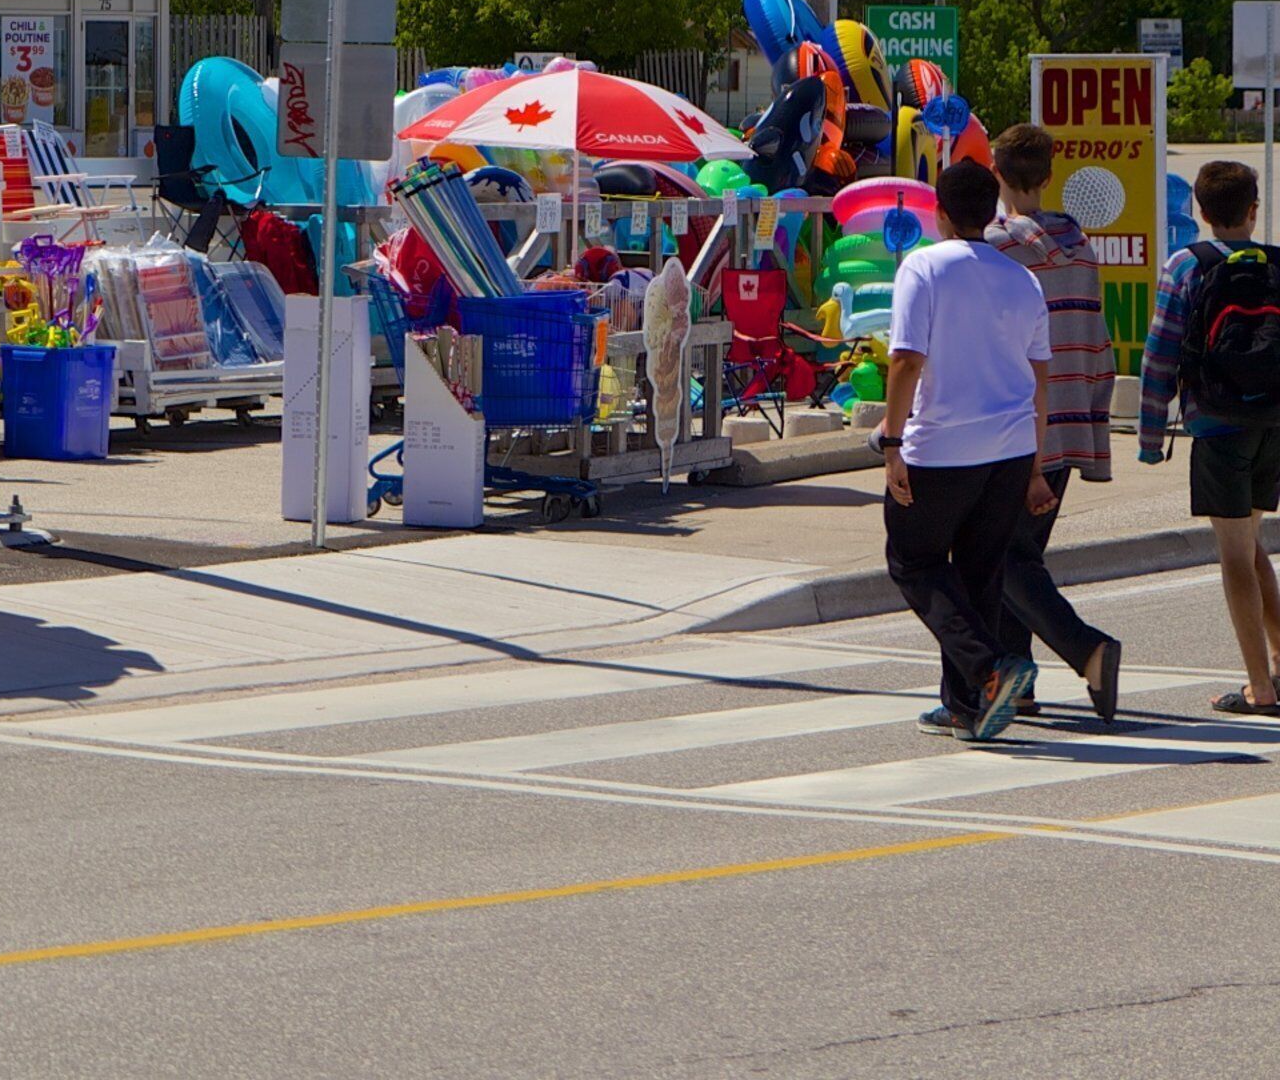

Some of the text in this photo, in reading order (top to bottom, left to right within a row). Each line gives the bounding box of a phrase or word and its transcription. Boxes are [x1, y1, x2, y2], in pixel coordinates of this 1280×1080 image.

[10, 21, 36, 31] CHILI
[888, 11, 936, 30] CASH
[5, 32, 50, 43] POUTINE
[1042, 67, 1152, 126] OPEN
[595, 133, 669, 145] CANADA
[1051, 139, 1142, 160] PEDRO'S
